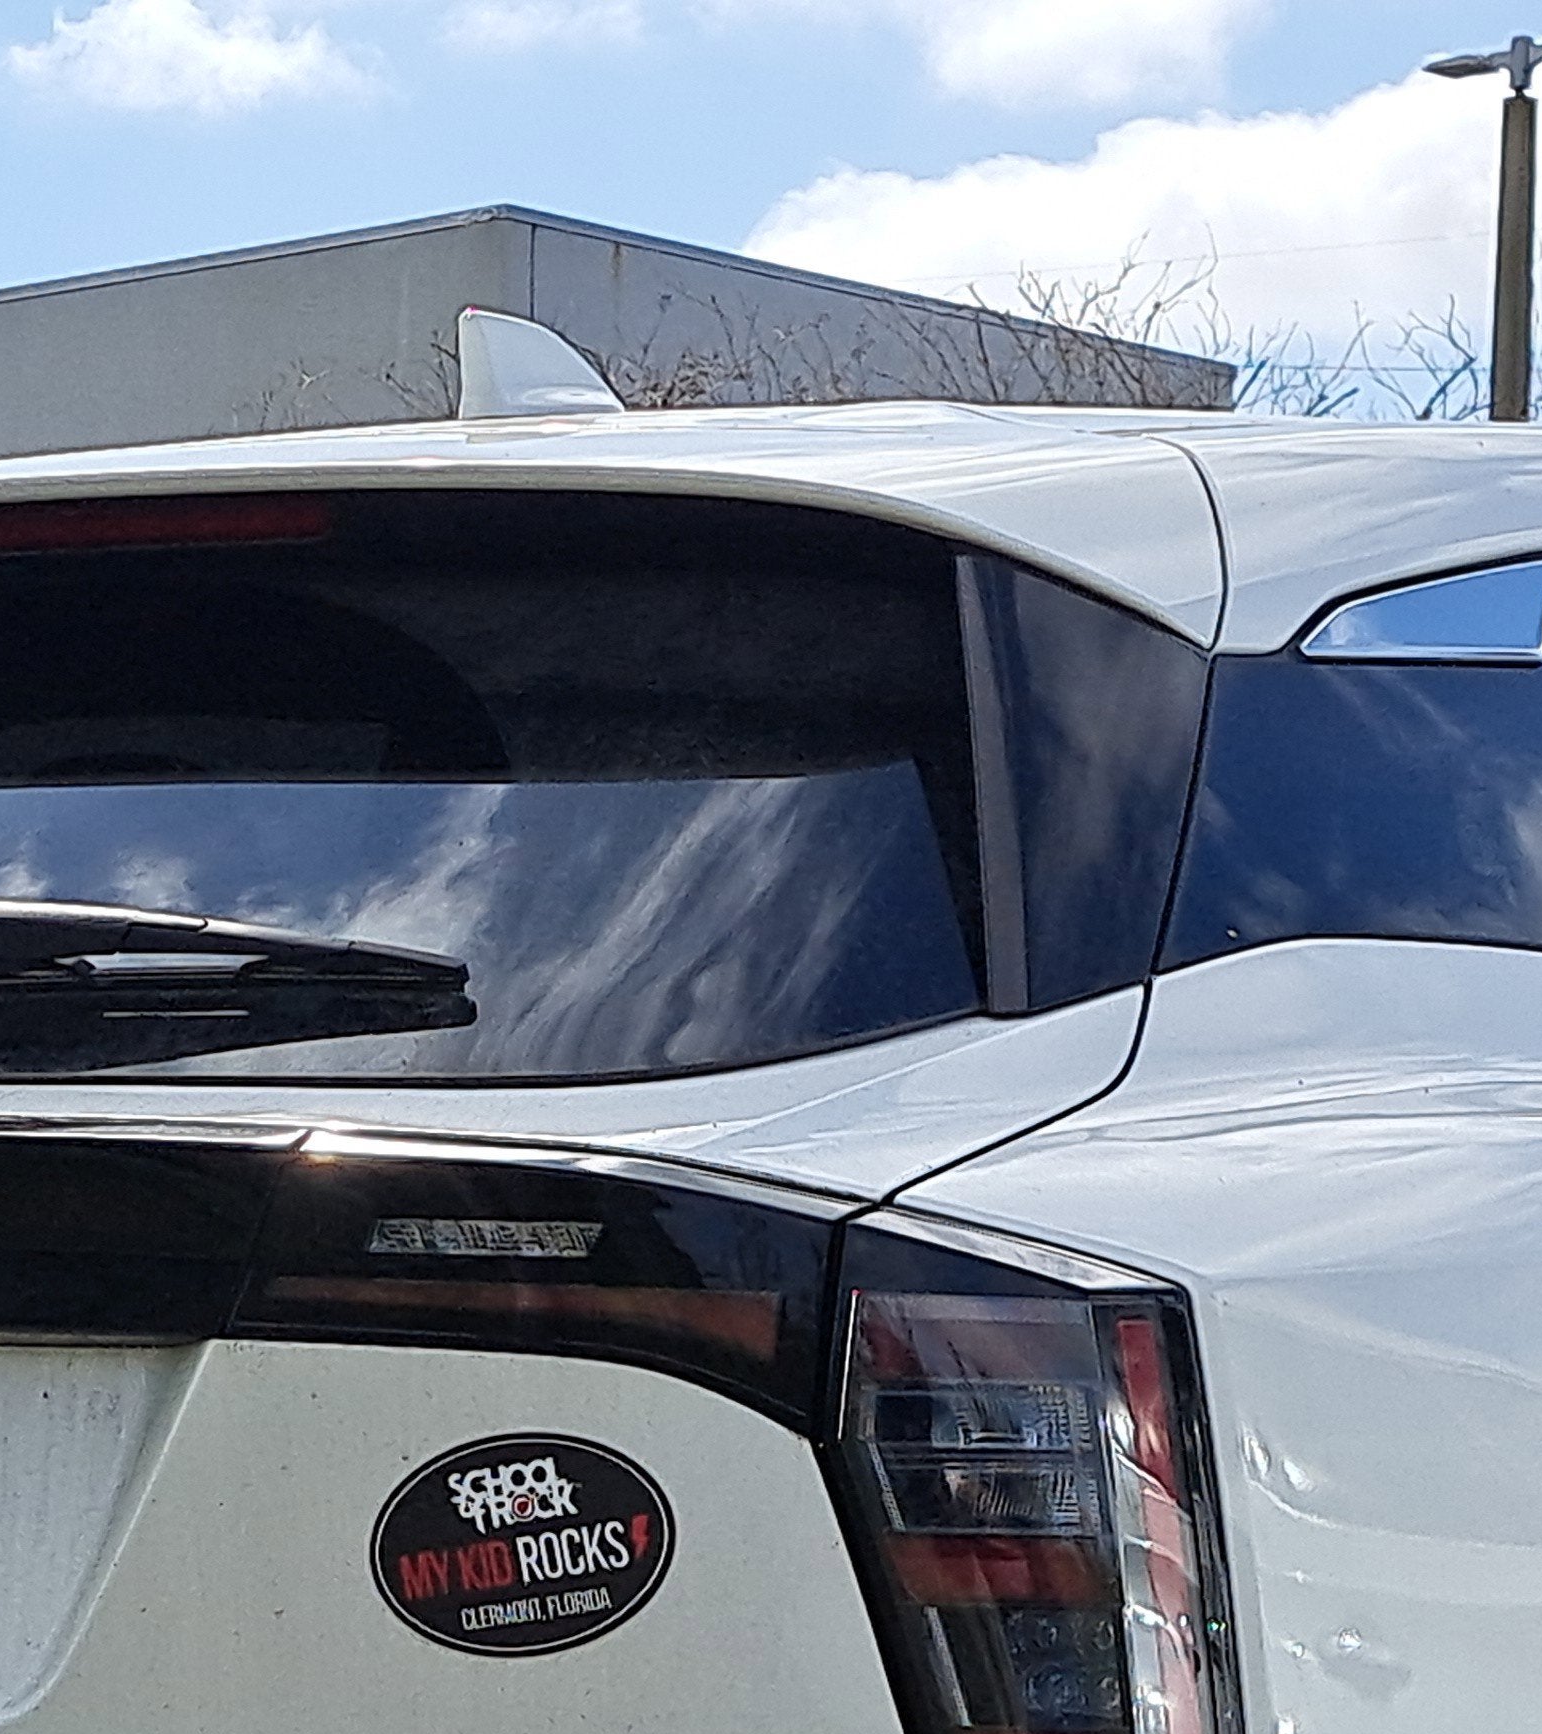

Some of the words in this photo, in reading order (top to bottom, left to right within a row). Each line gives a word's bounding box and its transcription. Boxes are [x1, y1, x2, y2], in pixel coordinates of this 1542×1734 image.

[447, 1456, 557, 1501] SCHOOL
[399, 1550, 449, 1600] MY
[457, 1541, 515, 1590] KID
[516, 1520, 629, 1584] ROCKS
[546, 1586, 612, 1620] FLORIDA
